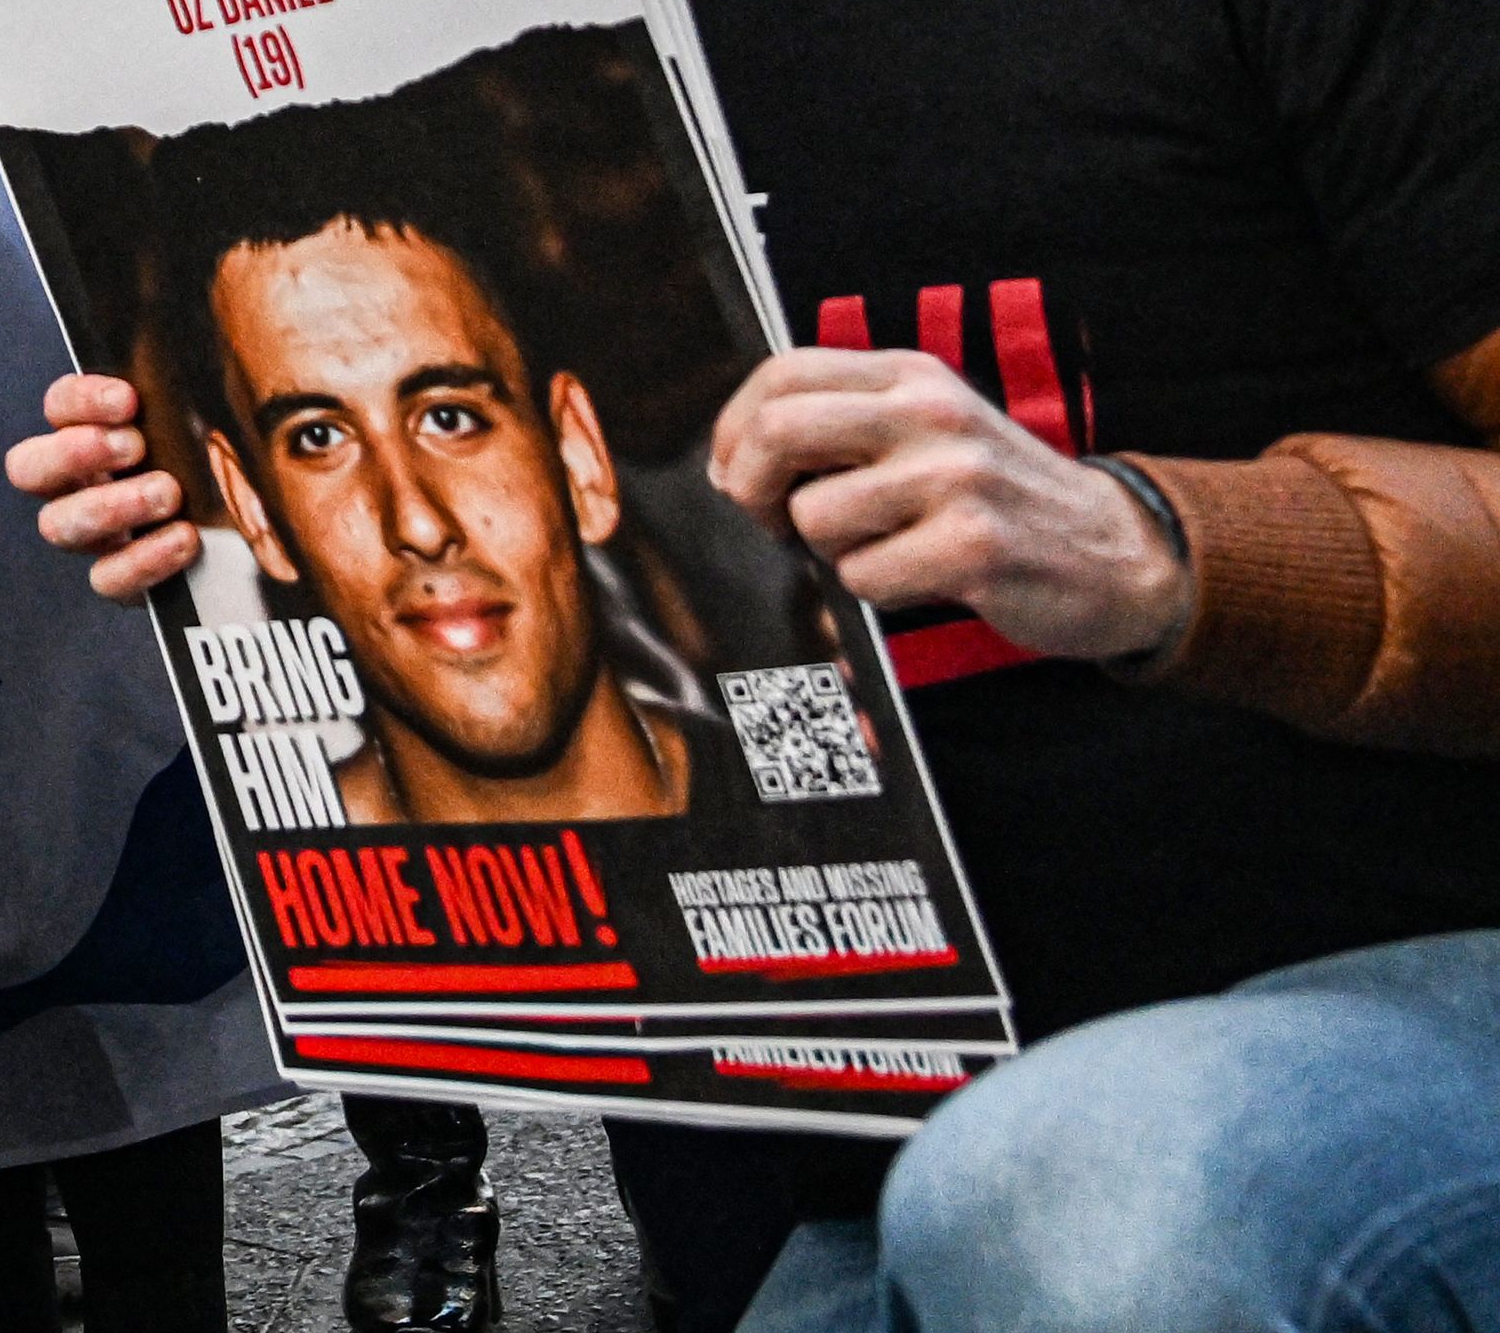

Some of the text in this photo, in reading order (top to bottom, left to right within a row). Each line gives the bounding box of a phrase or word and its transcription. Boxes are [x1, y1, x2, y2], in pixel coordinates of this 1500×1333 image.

[231, 23, 305, 99] (19)
[184, 617, 365, 727] BRING
[217, 729, 347, 831] HIM
[256, 828, 618, 949] HOME NOW!
[668, 860, 928, 906] HOSTAGES AND MISSING
[682, 896, 948, 960] FAMILIES FORUM
